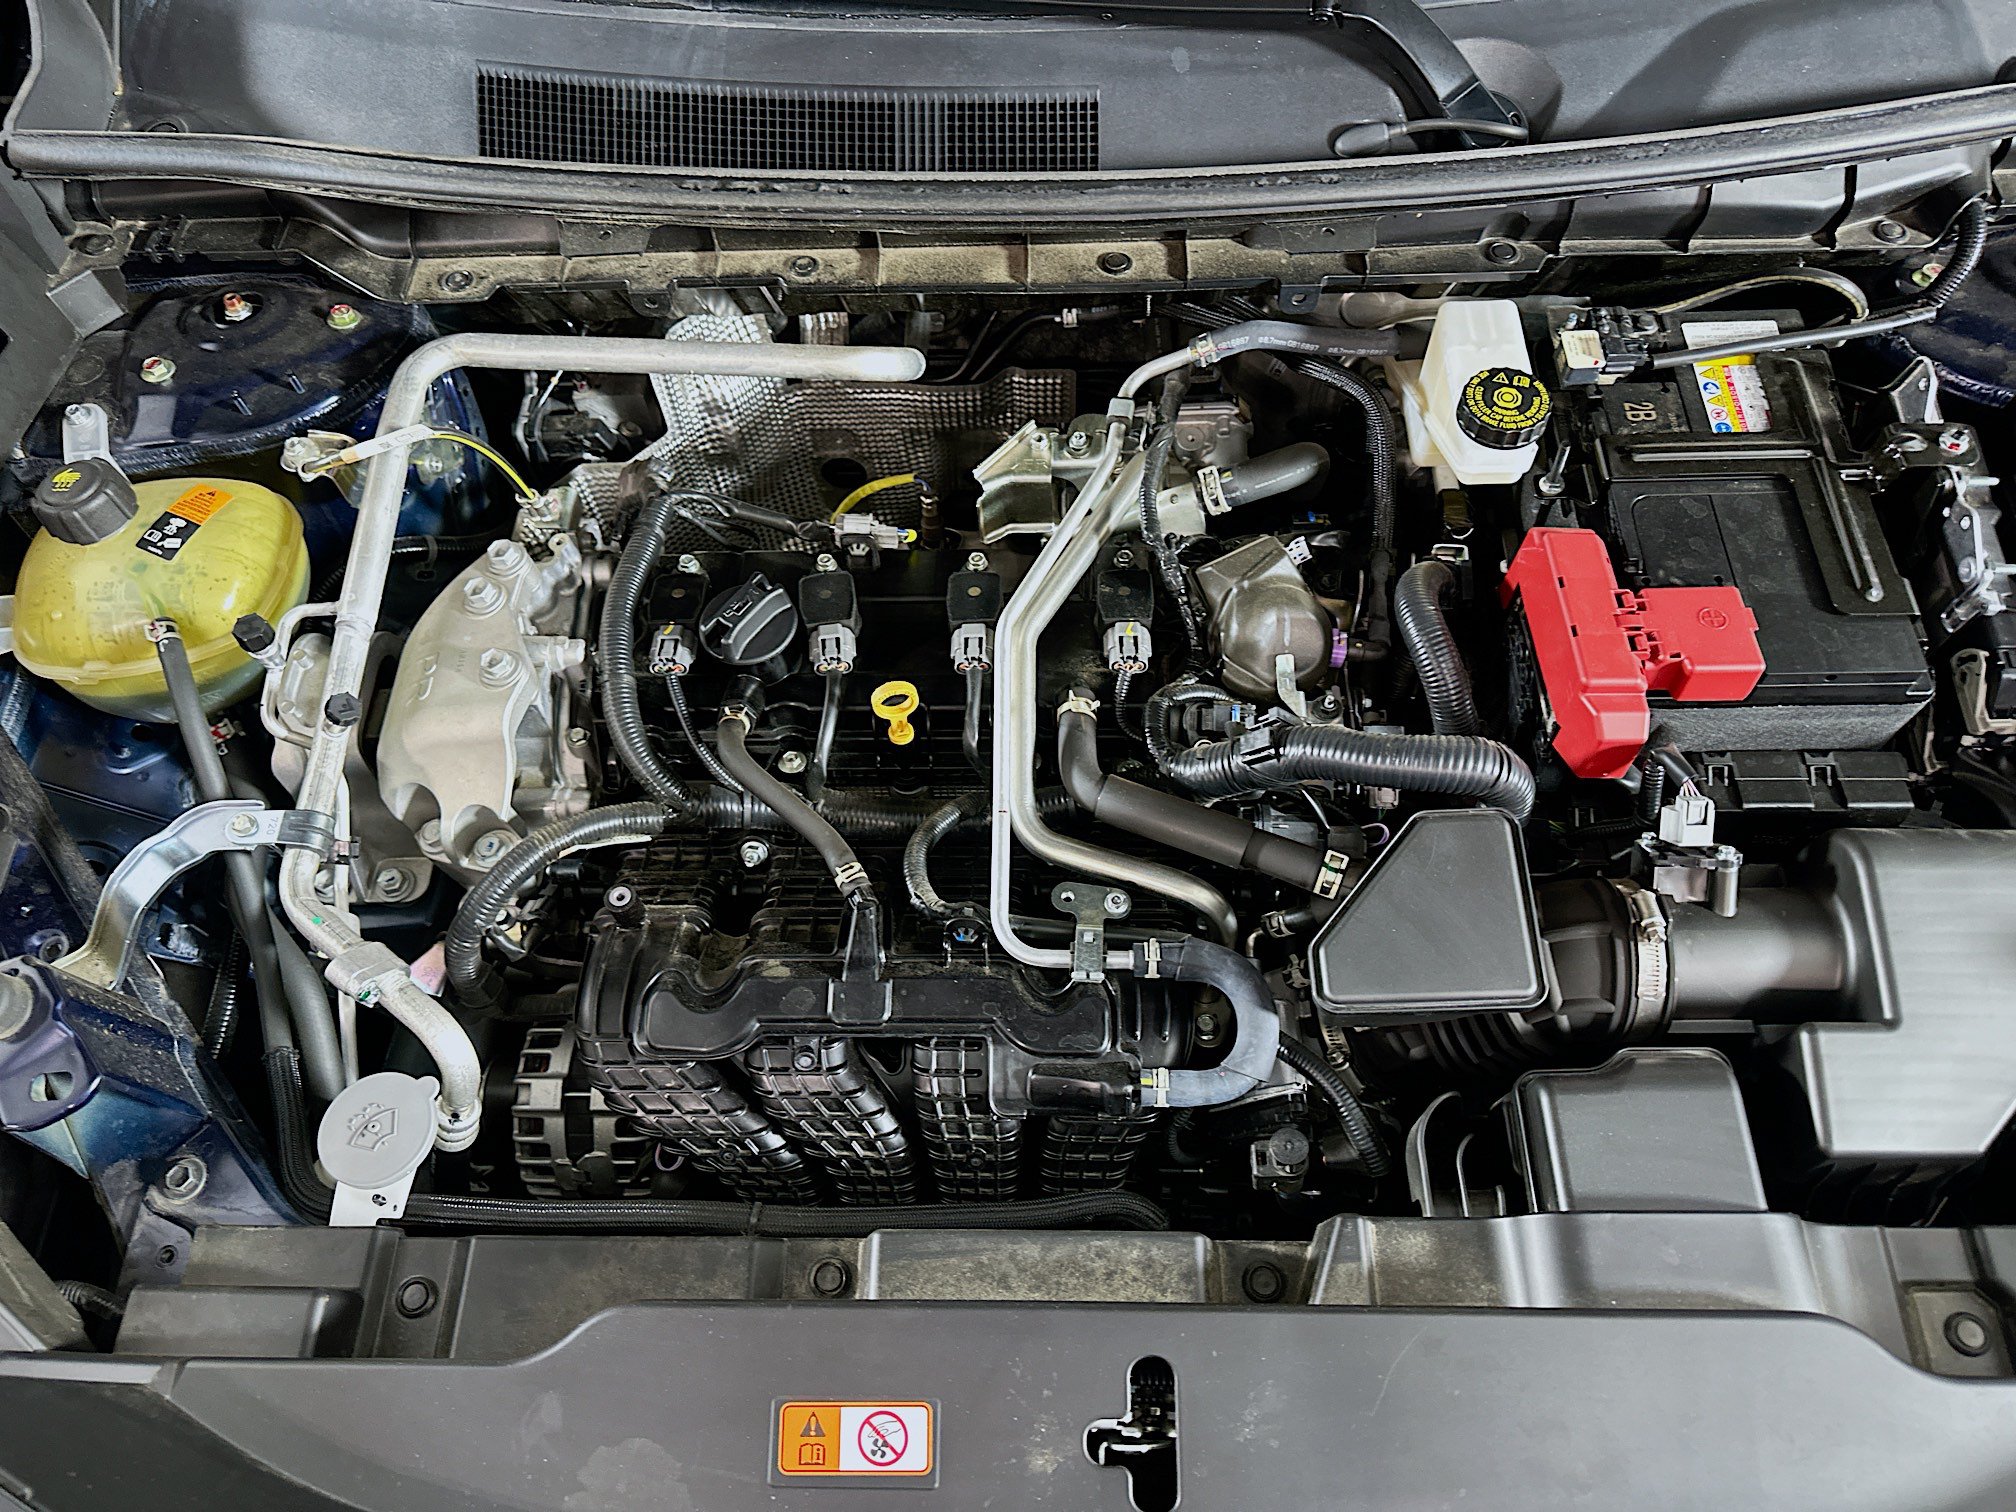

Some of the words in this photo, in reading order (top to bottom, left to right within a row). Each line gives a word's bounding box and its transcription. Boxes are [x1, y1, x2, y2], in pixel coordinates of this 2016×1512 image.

[1287, 340, 1320, 352] GB16897
[1476, 401, 1492, 415] FILLER
[1623, 401, 1658, 422] 2B
[1480, 415, 1499, 427] BRAKE
[1517, 420, 1534, 428] FROM
